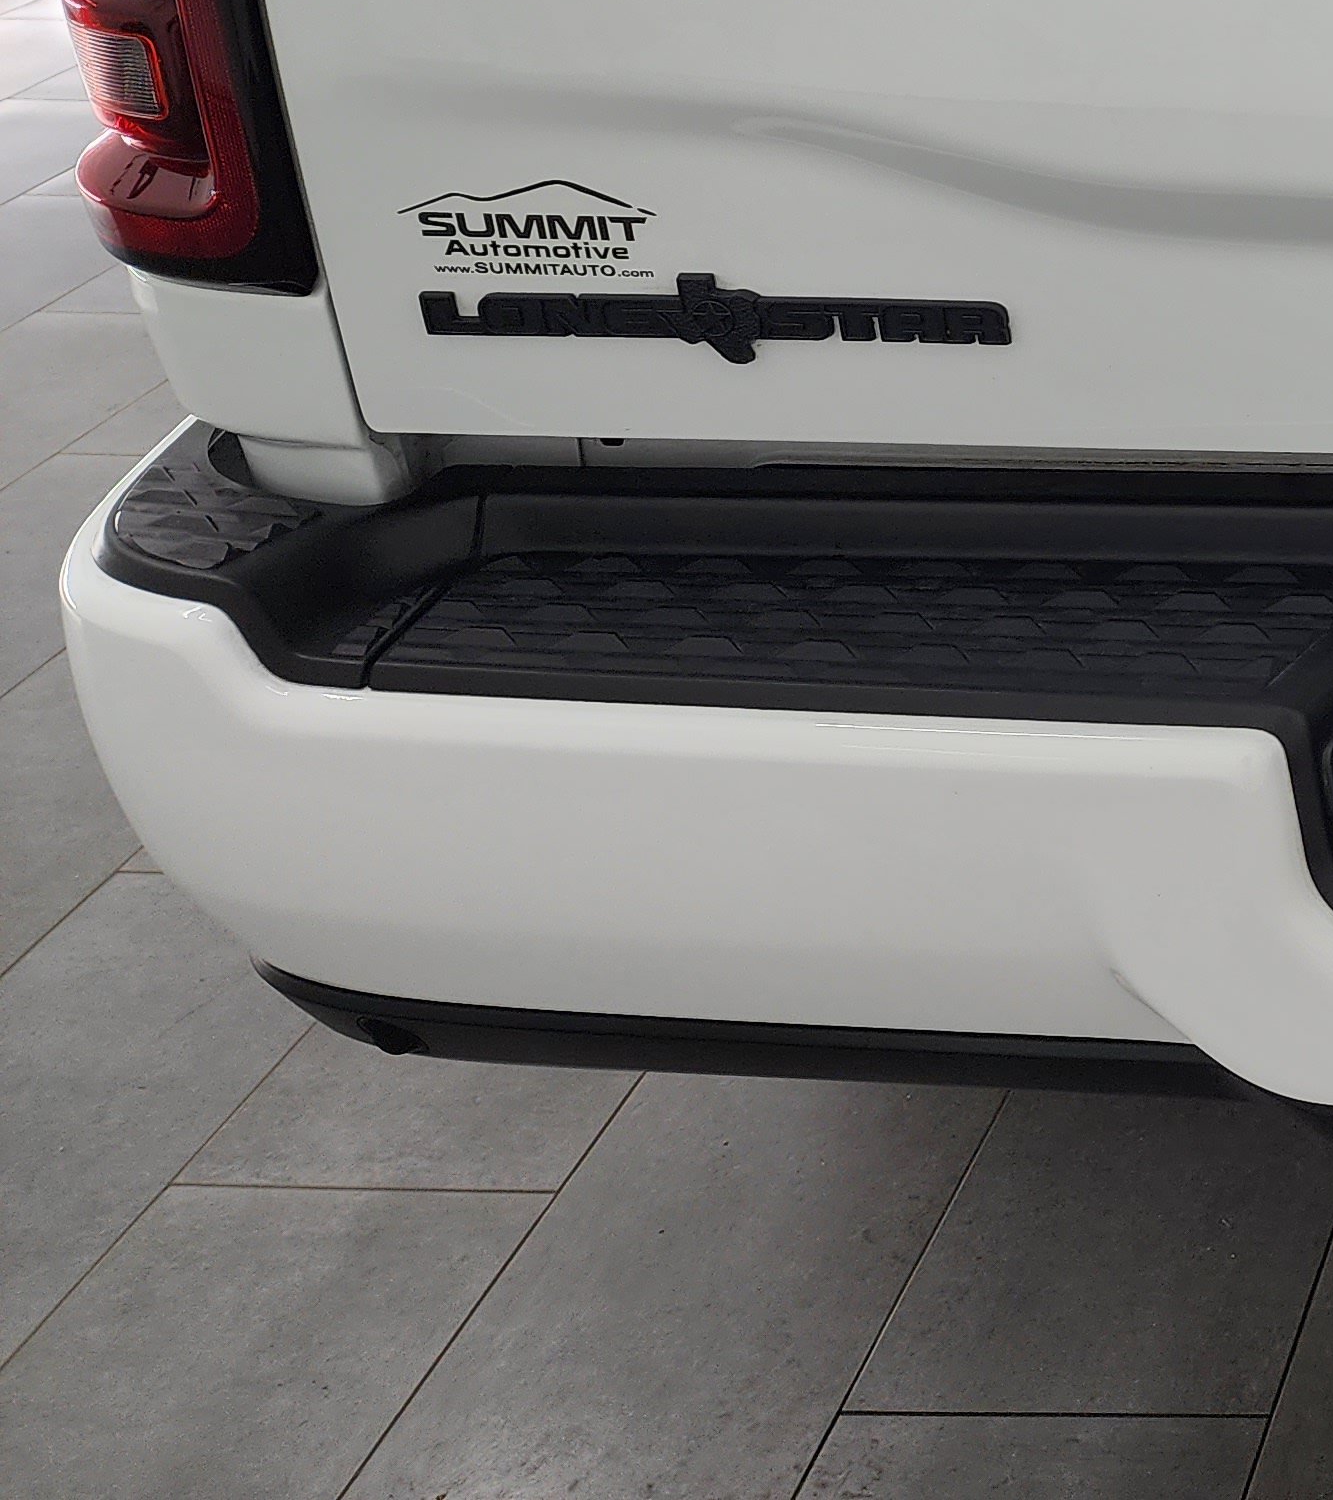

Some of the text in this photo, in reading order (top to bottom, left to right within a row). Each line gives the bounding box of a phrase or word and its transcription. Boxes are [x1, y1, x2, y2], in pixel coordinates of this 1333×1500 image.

[417, 211, 648, 242] SUMMIT
[445, 239, 630, 260] Automotive
[434, 261, 655, 278] www.SUMMITAUTO.com
[419, 291, 1012, 346] LONE STAR
